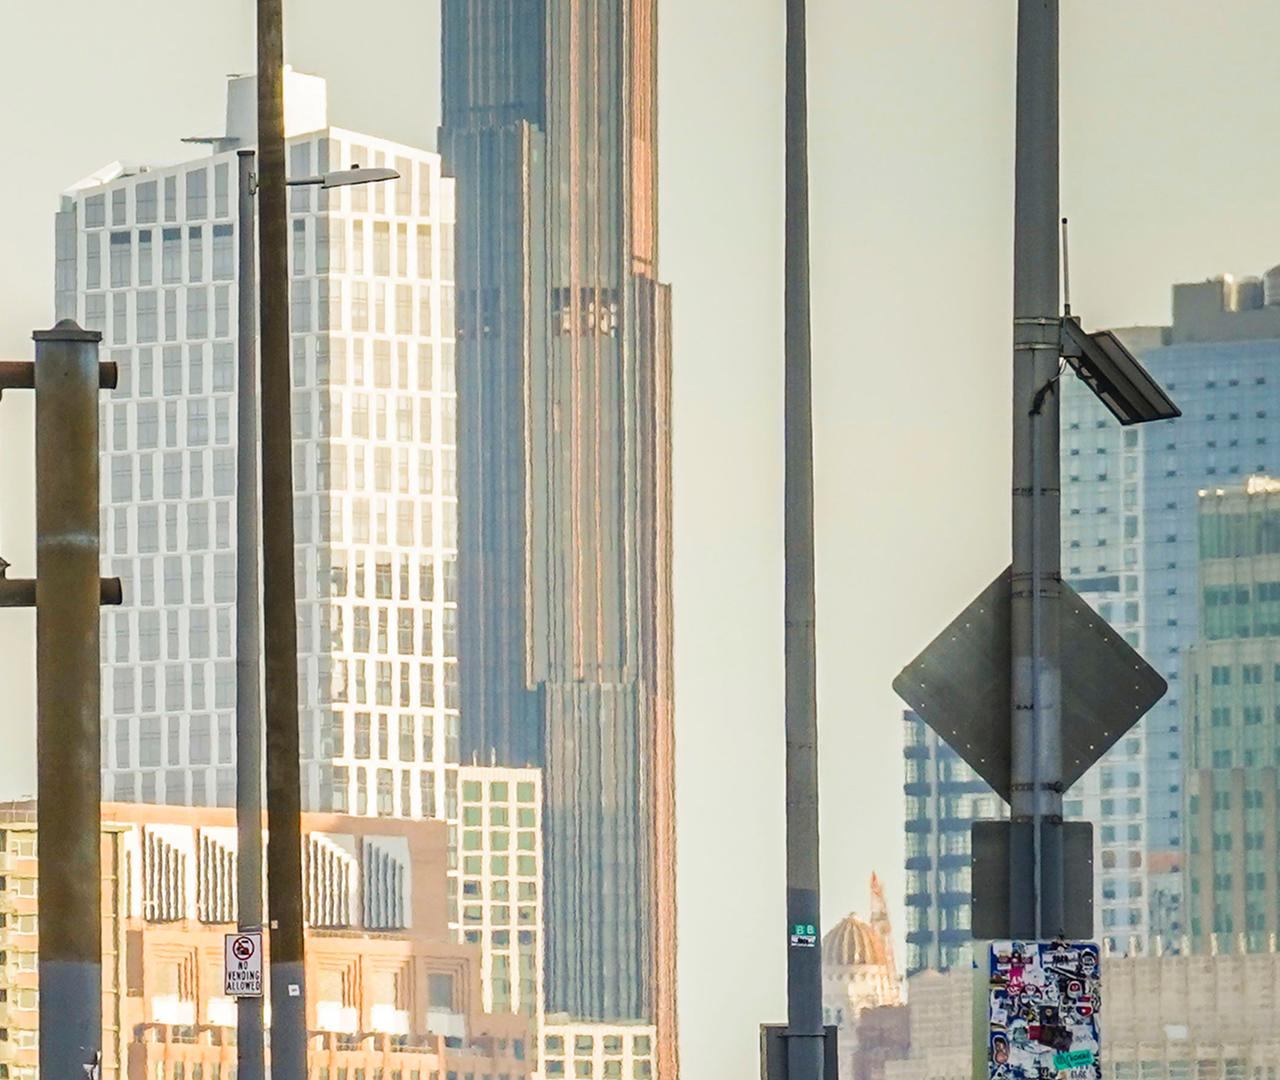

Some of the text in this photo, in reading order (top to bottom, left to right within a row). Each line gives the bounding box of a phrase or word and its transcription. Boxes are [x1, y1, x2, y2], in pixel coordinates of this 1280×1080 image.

[238, 961, 249, 970] NO
[228, 971, 260, 980] VENDING
[226, 981, 260, 991] ALLOWED
